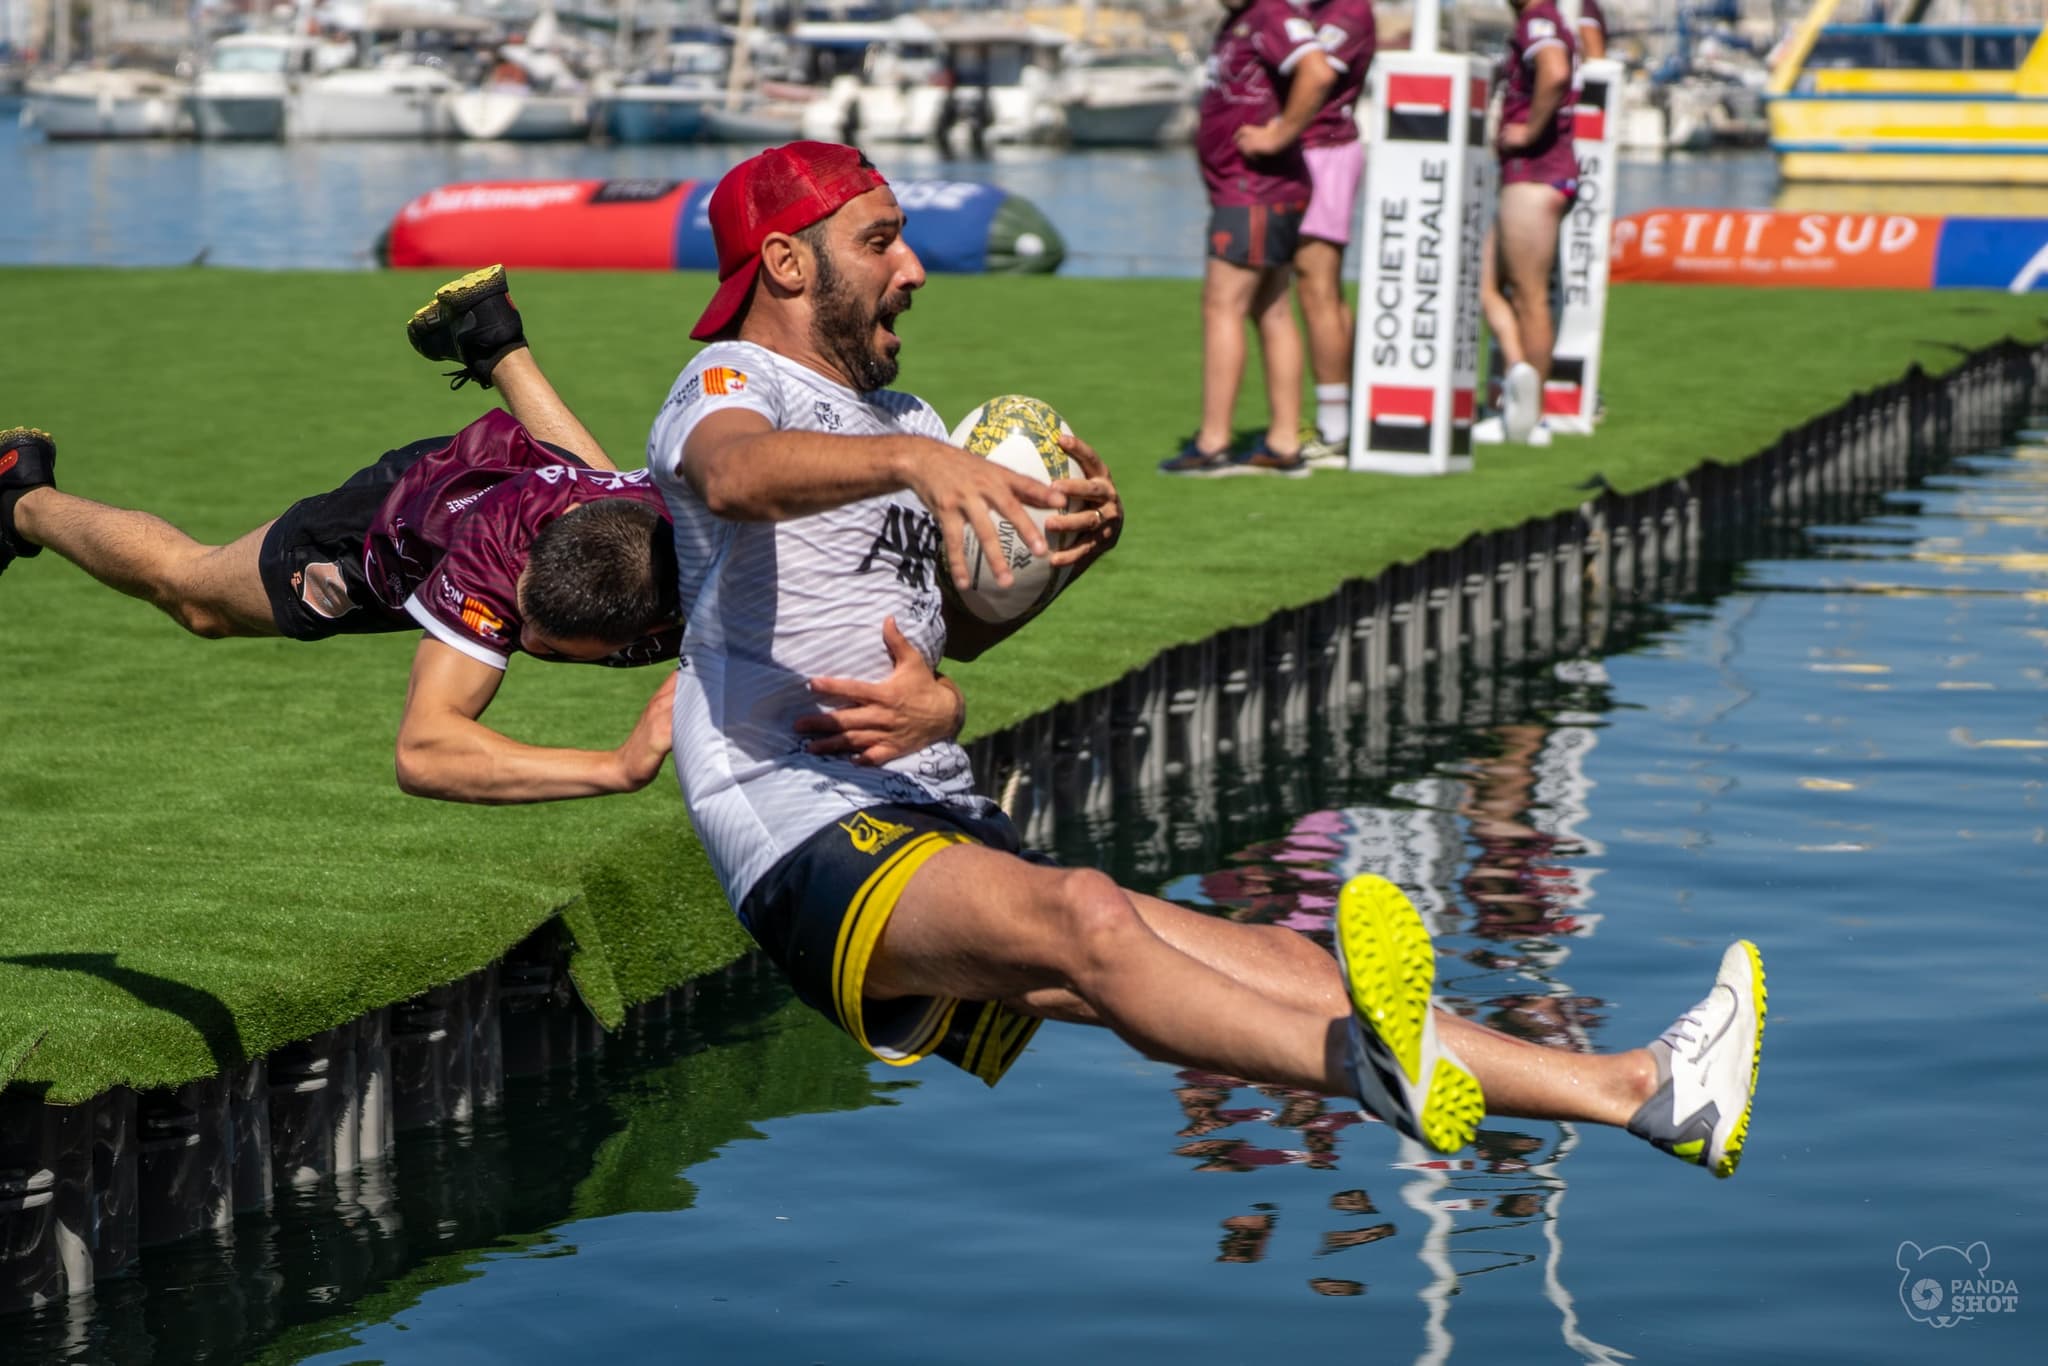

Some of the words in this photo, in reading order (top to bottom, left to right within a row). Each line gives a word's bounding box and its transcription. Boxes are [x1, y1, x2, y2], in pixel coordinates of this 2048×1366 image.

[1373, 198, 1408, 367] SOCIETE
[1411, 159, 1447, 370] GENERALE
[1610, 212, 1773, 262] PETIT
[1793, 213, 1919, 256] SUD
